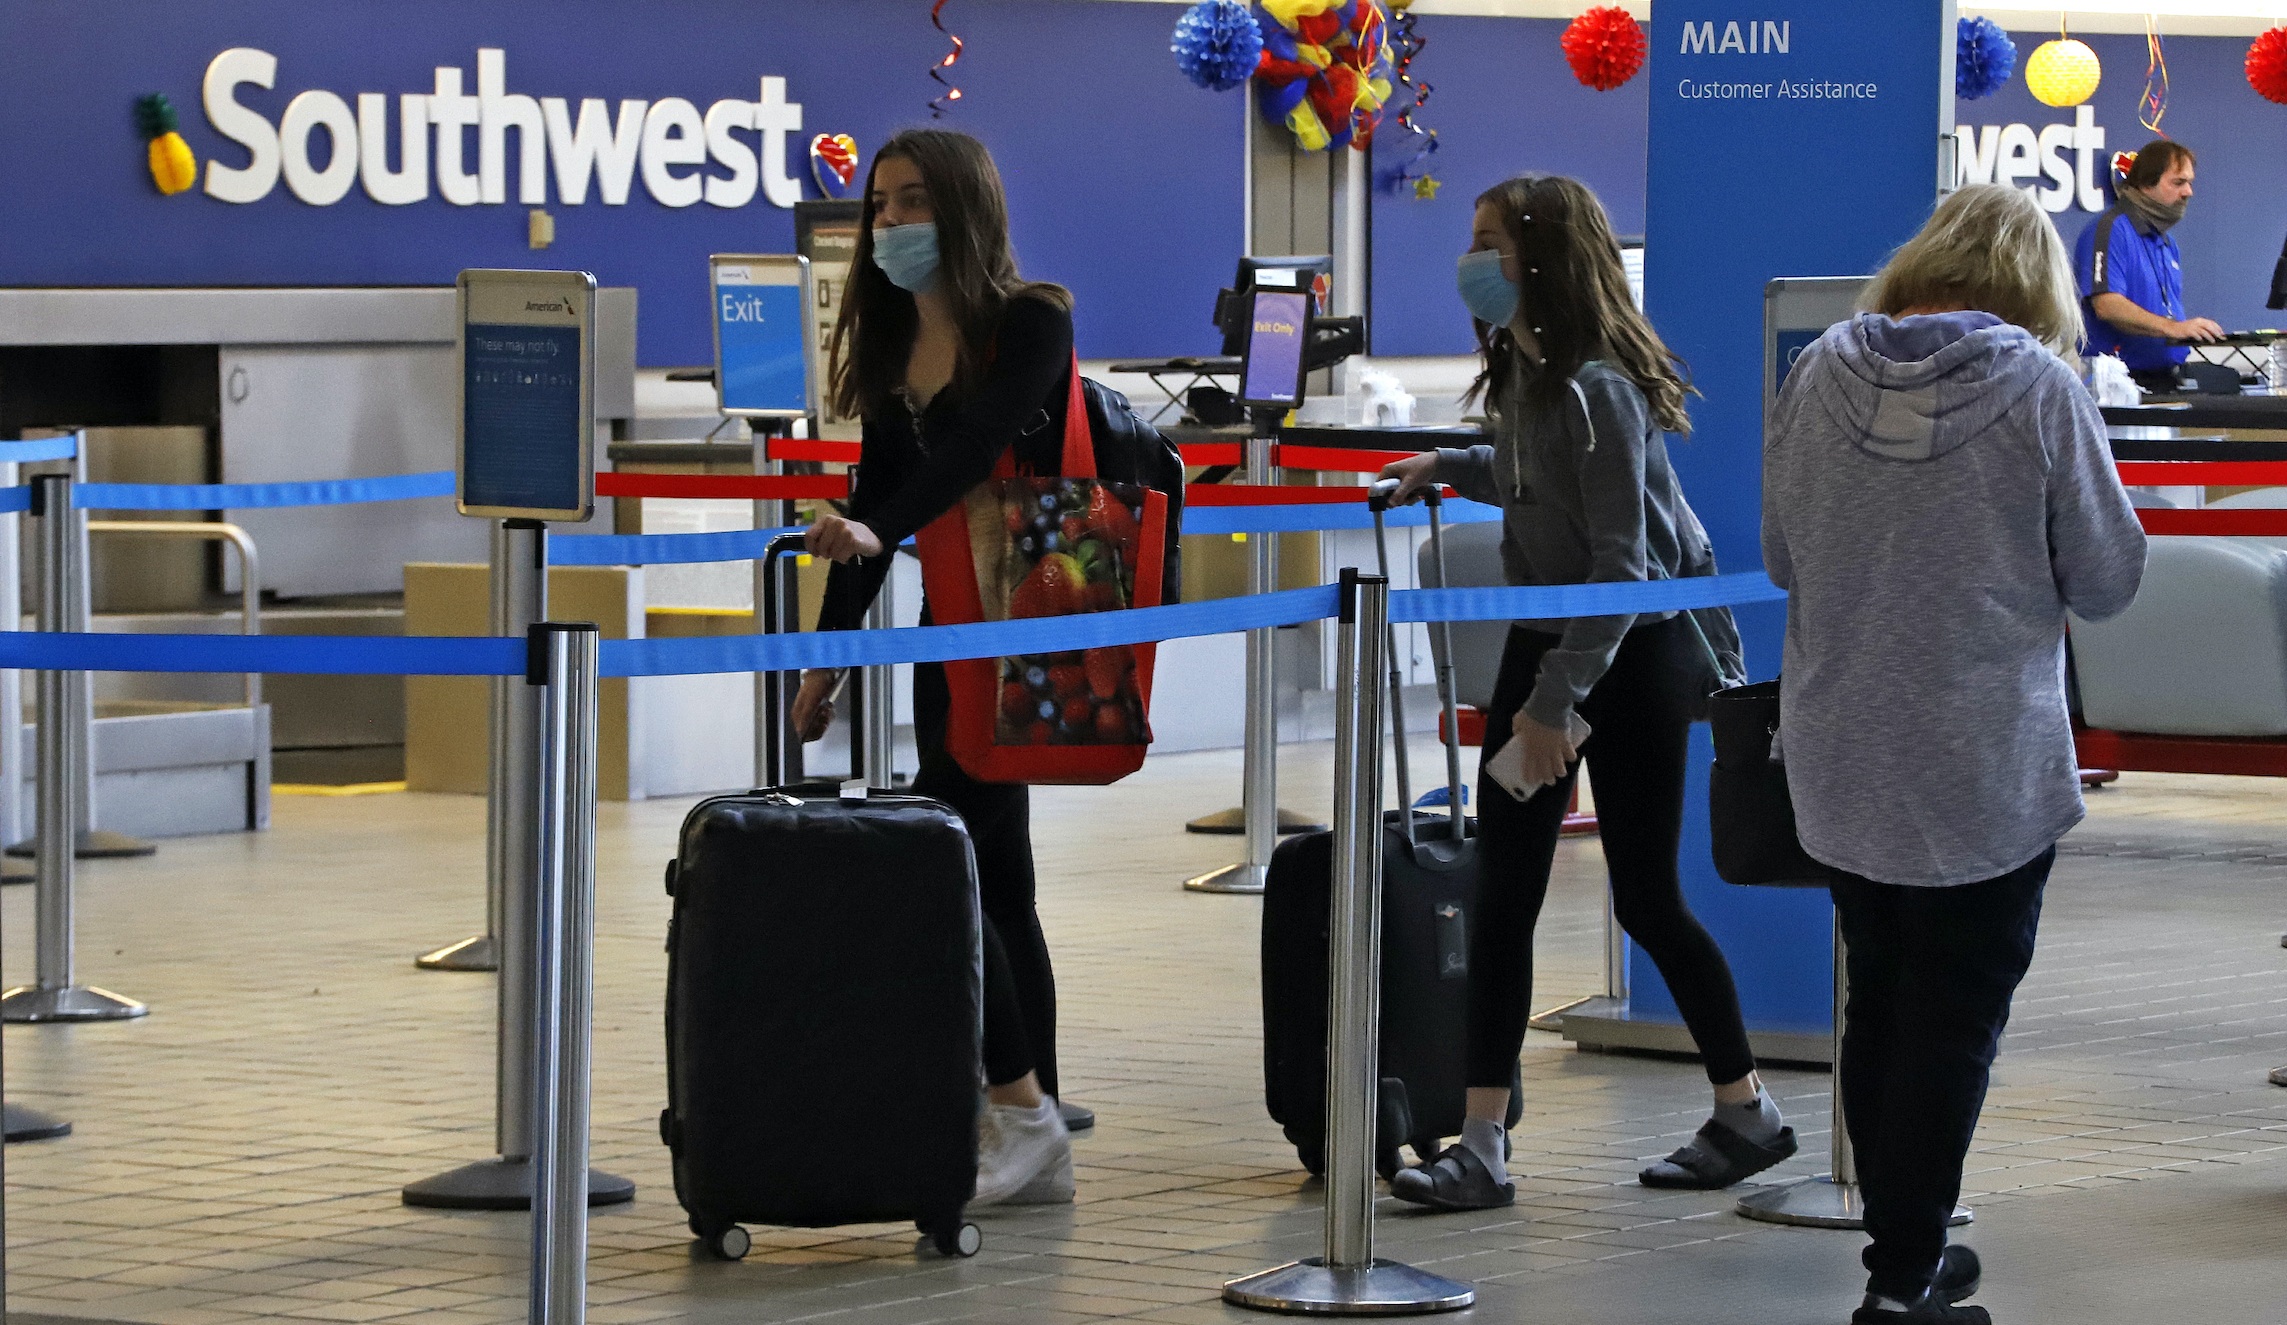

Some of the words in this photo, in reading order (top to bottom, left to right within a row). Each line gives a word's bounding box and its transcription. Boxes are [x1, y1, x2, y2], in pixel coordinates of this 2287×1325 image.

[1680, 20, 1790, 54] MAIN
[1678, 79, 1772, 99] Customer
[1777, 78, 1877, 99] Assistance
[203, 47, 801, 208] Southwest
[525, 301, 562, 312] American
[722, 294, 764, 322] Exit
[1254, 321, 1272, 333] Exit
[1273, 322, 1295, 336] Only
[475, 337, 503, 351] These
[505, 340, 525, 355] may
[528, 340, 544, 352] not
